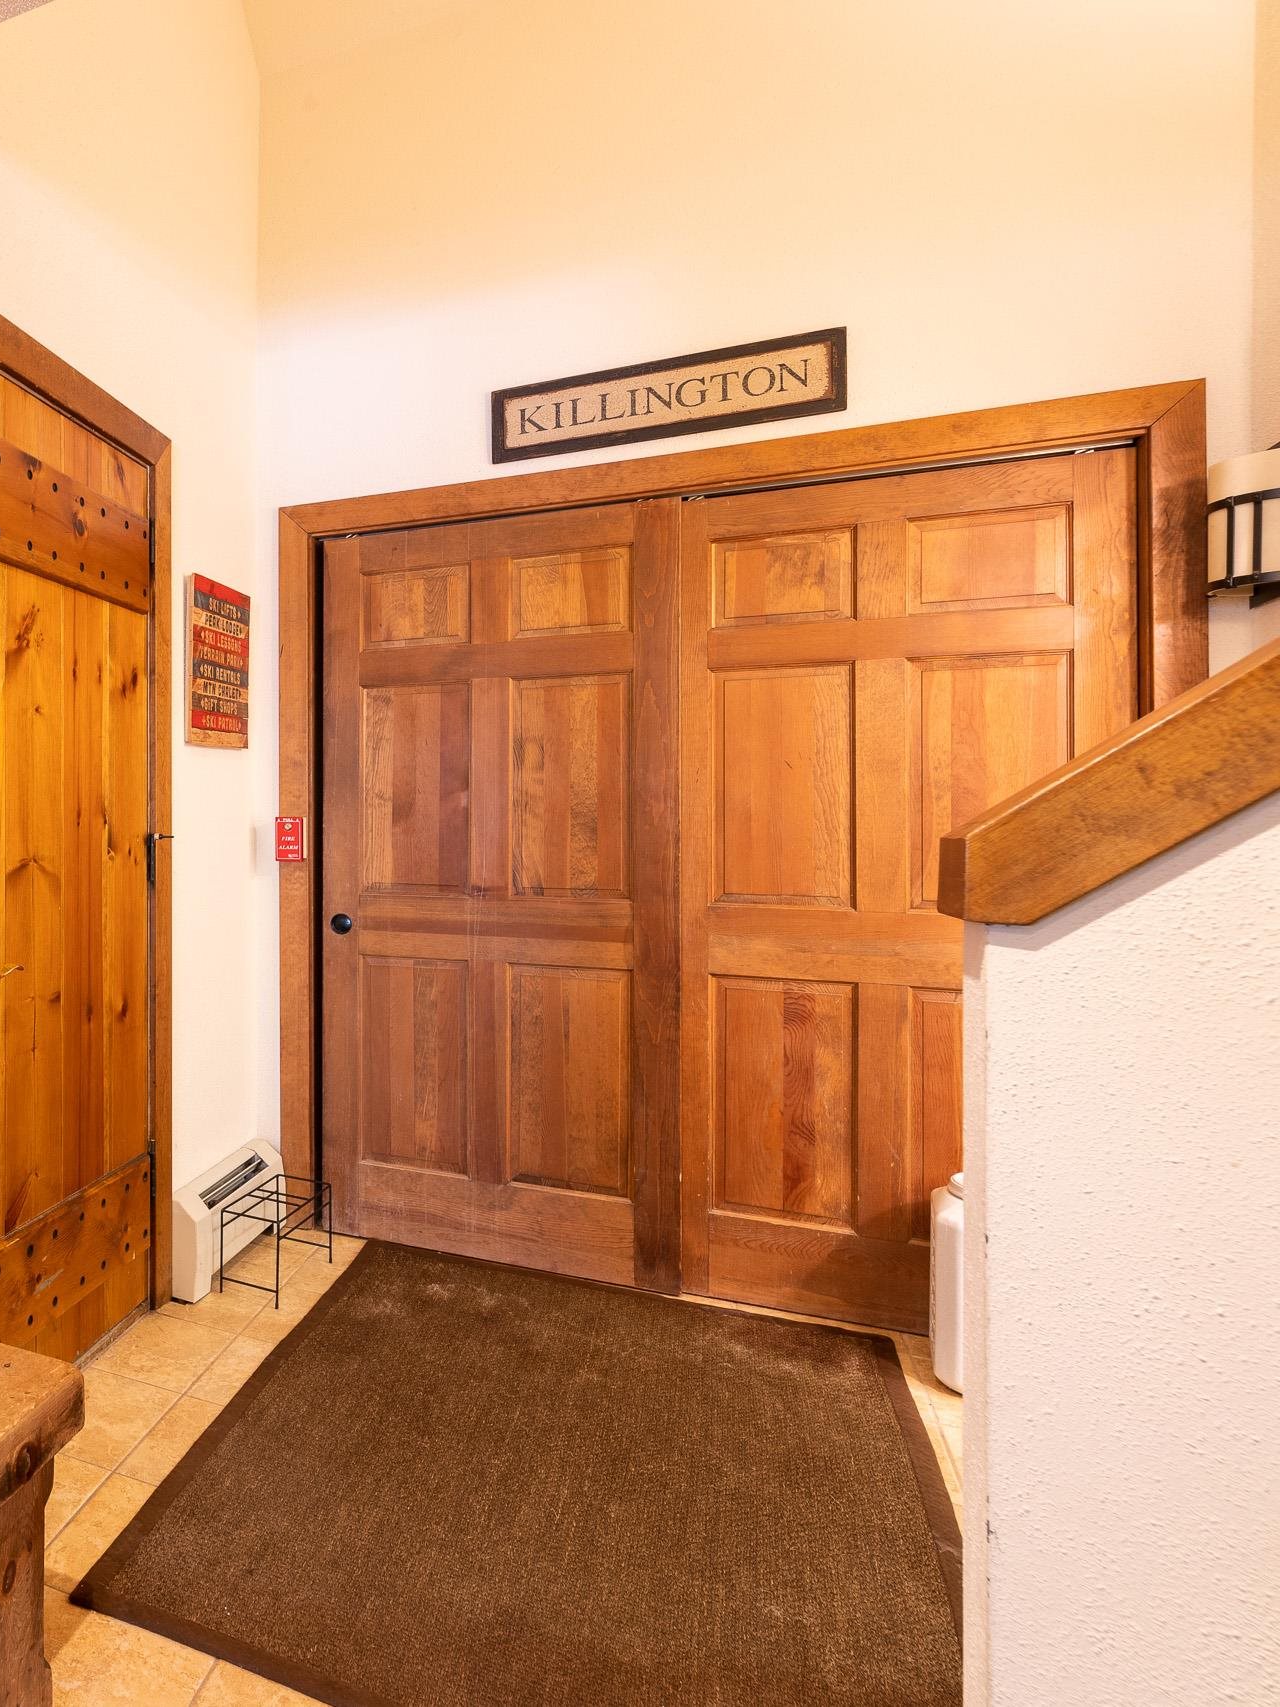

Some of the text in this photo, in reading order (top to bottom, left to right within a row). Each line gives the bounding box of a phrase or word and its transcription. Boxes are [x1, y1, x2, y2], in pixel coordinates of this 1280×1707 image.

[518, 358, 810, 435] KILLINGTON
[208, 598, 236, 619] SKI LIFTS
[205, 630, 241, 653] SKI LESSONS
[204, 664, 240, 685] SKI RENTALS
[204, 697, 237, 715] GIFT SHOPS
[206, 715, 239, 732] SKI PATROL
